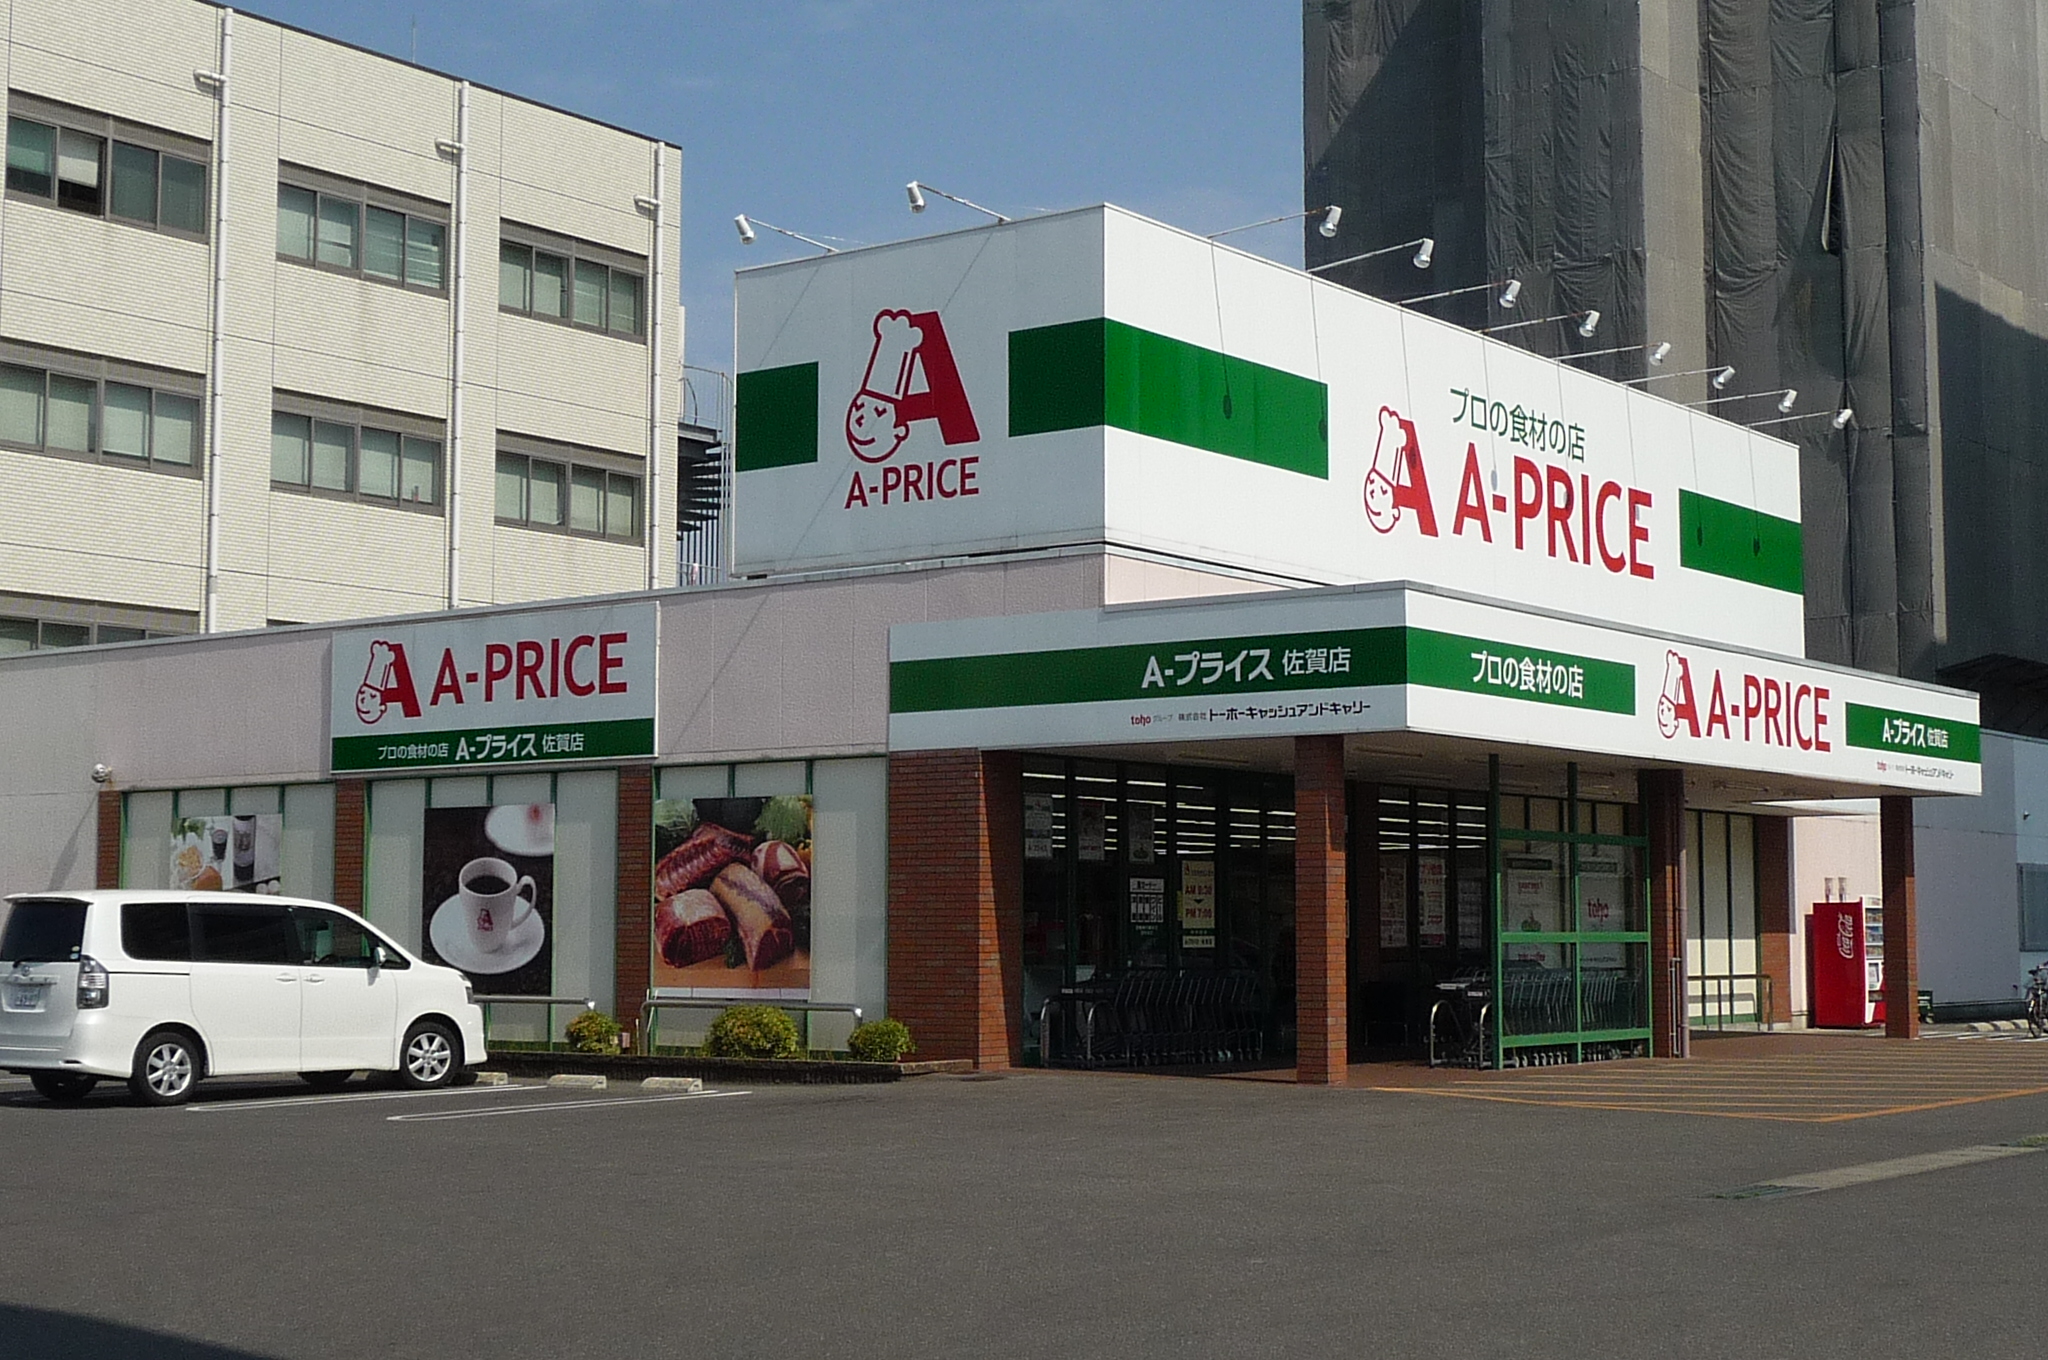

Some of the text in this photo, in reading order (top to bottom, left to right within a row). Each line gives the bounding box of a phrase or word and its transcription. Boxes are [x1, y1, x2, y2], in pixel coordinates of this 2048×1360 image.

[1450, 386, 1586, 462] プロの食材の店
[844, 455, 980, 511] A-PRICE
[1452, 441, 1655, 580] A-PRICE
[429, 631, 629, 707] A-PRICE
[1141, 646, 1352, 689] A-プライス 佐賀店
[1470, 649, 1584, 699] プロの食材の店
[1130, 714, 1152, 728] toho
[1208, 700, 1372, 722] トーホーキャッシュアンドキャリー
[1705, 668, 1831, 754] A-PRICE
[377, 742, 449, 761] プロの食材の店
[455, 732, 585, 762] A-プライス 佐賀店
[1587, 898, 1610, 923] toho
